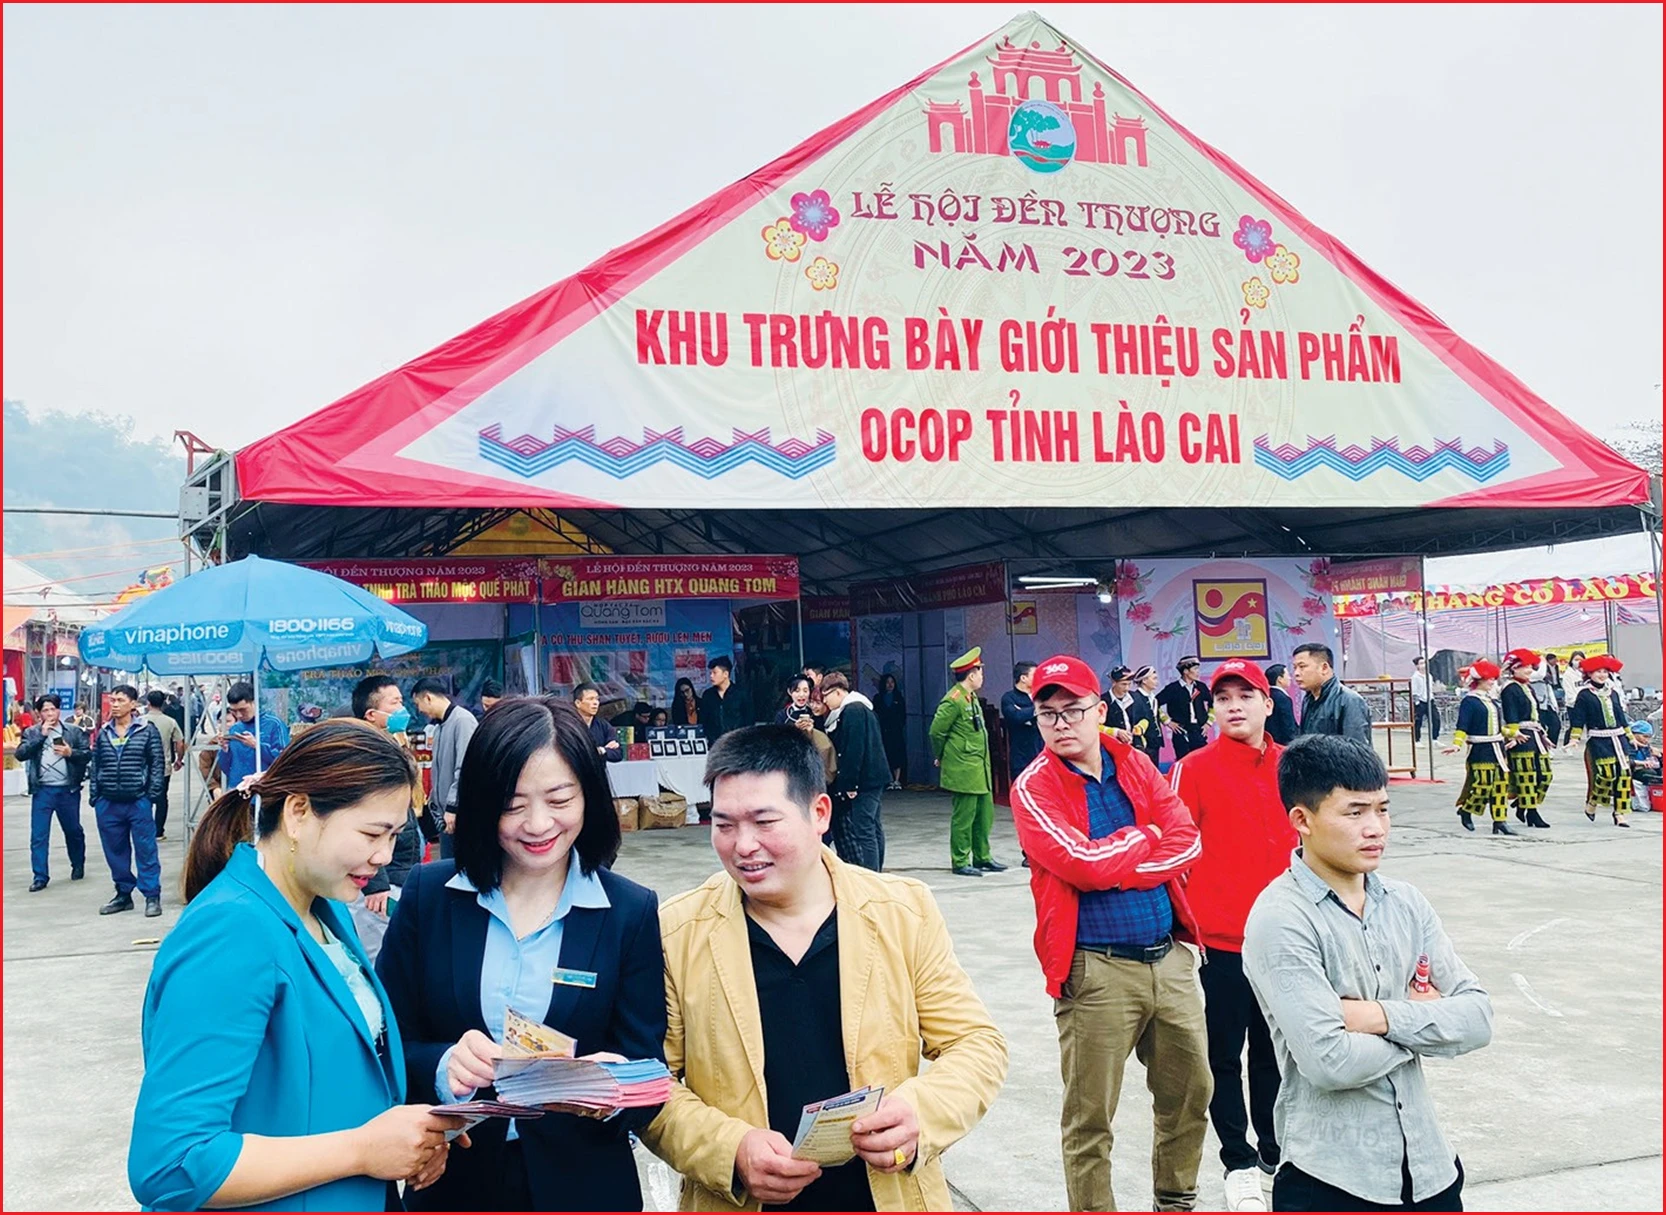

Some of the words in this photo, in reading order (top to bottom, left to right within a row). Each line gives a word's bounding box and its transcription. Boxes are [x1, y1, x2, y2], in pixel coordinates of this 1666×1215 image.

[850, 182, 898, 220] LỄ
[908, 188, 982, 227] HỘI
[990, 189, 1068, 227] ĐỀN
[1077, 200, 1221, 239] THƯỢNG
[912, 232, 1040, 274] NĂM
[1062, 246, 1176, 280] 2023
[635, 309, 729, 366] KHU
[742, 310, 891, 370] TRƯNG
[904, 306, 984, 372] BÀY
[999, 305, 1080, 374] GIỚI
[1090, 314, 1200, 388] THIỆU
[1212, 307, 1289, 380] SẢN
[1298, 314, 1402, 384] PHẨM
[860, 407, 974, 463] OCOP
[986, 389, 1080, 464] TỈNH
[1092, 400, 1166, 465] LÀO
[1178, 412, 1241, 465] CAI
[458, 566, 486, 576] 2023
[728, 563, 753, 572] 2023
[396, 579, 417, 599] TRÀ
[420, 577, 449, 599] THẢO
[562, 579, 601, 597] GIAN
[606, 576, 649, 595] HÀNG
[655, 577, 684, 594] HTX
[688, 576, 740, 595] QUANG
[743, 577, 776, 593] TOM
[581, 605, 630, 620] Quang
[633, 604, 663, 616] Tom
[125, 623, 229, 645] vinaphone
